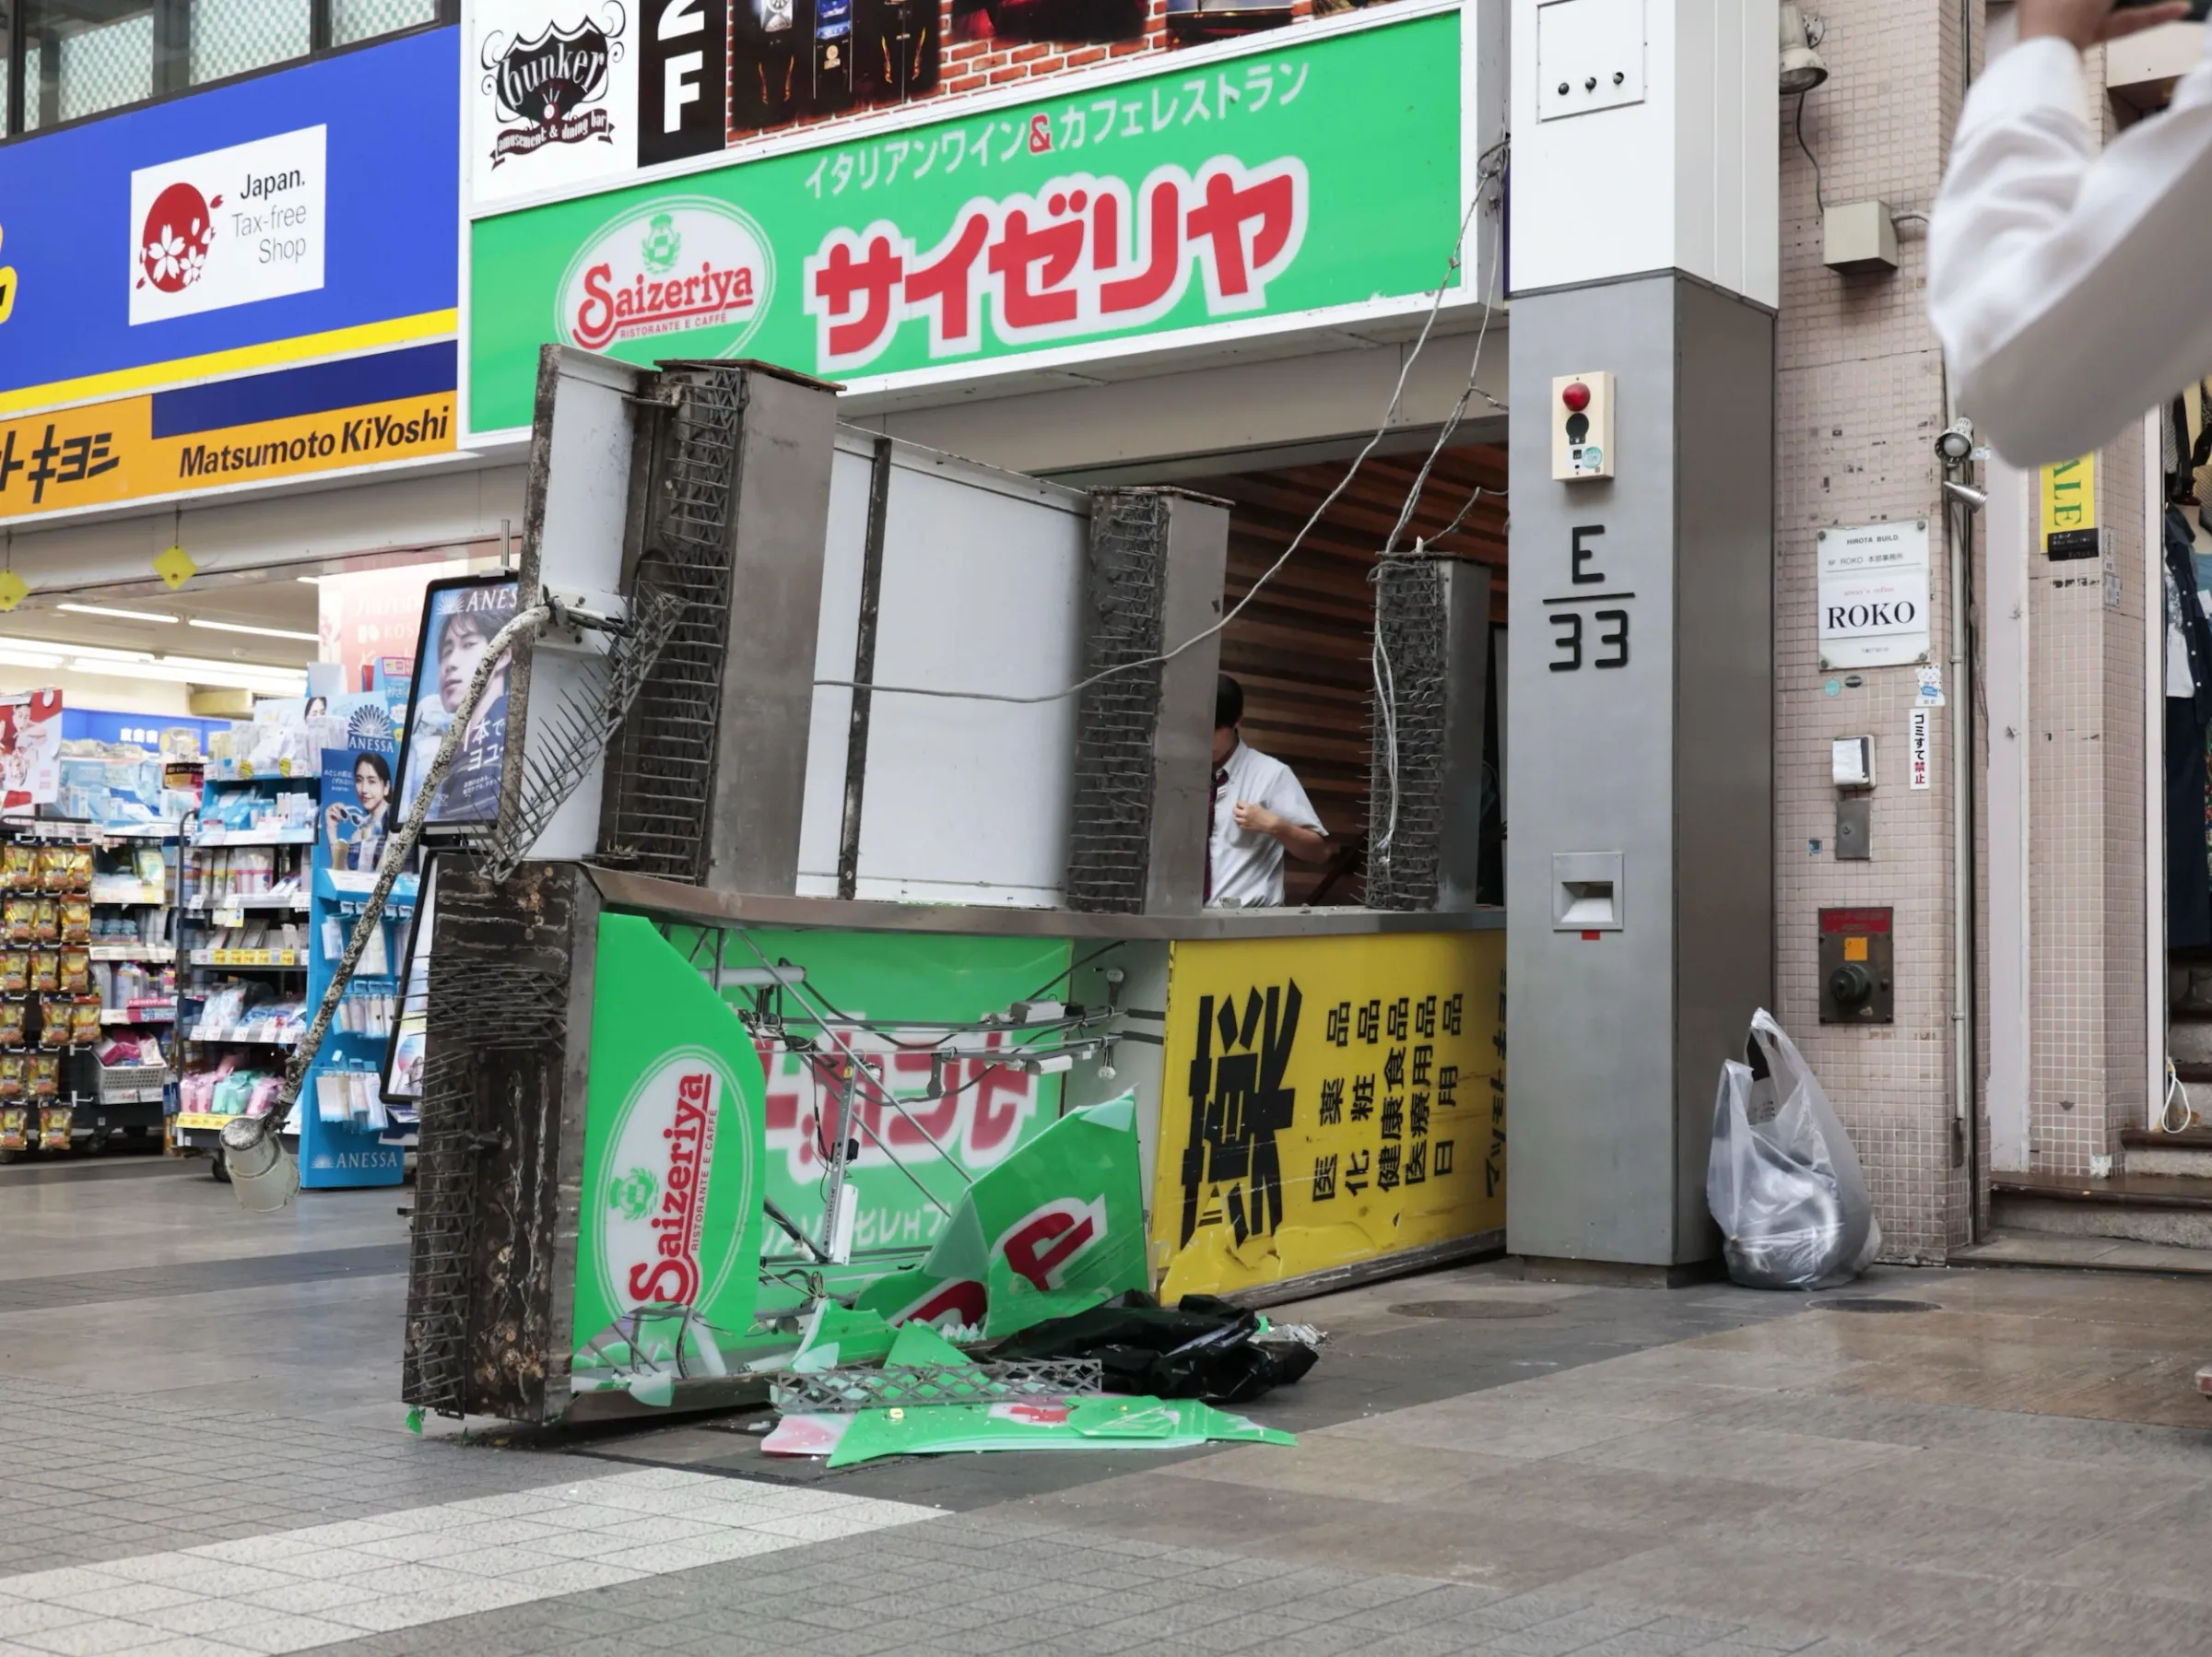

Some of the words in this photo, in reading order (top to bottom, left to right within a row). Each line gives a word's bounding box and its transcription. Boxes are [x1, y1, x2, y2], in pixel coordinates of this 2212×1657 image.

[501, 42, 605, 110] bunker
[497, 125, 547, 152] amusement
[561, 117, 588, 139] dining
[590, 111, 606, 128] bar
[239, 168, 307, 201] Japan.
[230, 205, 307, 237] Tax-free
[258, 237, 307, 264] Shop
[809, 166, 1300, 363] サイゼリヤ
[572, 262, 754, 349] Saizeriya
[619, 321, 680, 339] RISTORANTE
[684, 319, 690, 329] E
[179, 430, 335, 477] Matsumoto
[340, 405, 450, 453] KiYoshi
[1571, 524, 1606, 584] E
[1840, 557, 1864, 565] ROKO
[1846, 536, 1873, 545] HIROTA
[1549, 609, 1629, 671] 33
[1827, 600, 1915, 629] ROKO
[348, 736, 394, 754] ANESSA
[1180, 977, 1303, 1251] 薬
[1312, 1002, 1351, 1202] 医薬品
[1345, 999, 1381, 1197] 化粧品
[1377, 996, 1409, 1193] 健康食品
[1406, 994, 1437, 1187] 医療用品
[1433, 992, 1464, 1177] 日用品
[335, 1151, 398, 1169] ANESSA
[629, 1073, 713, 1307] Saizeriya
[690, 1169, 709, 1252] RISTORANTE
